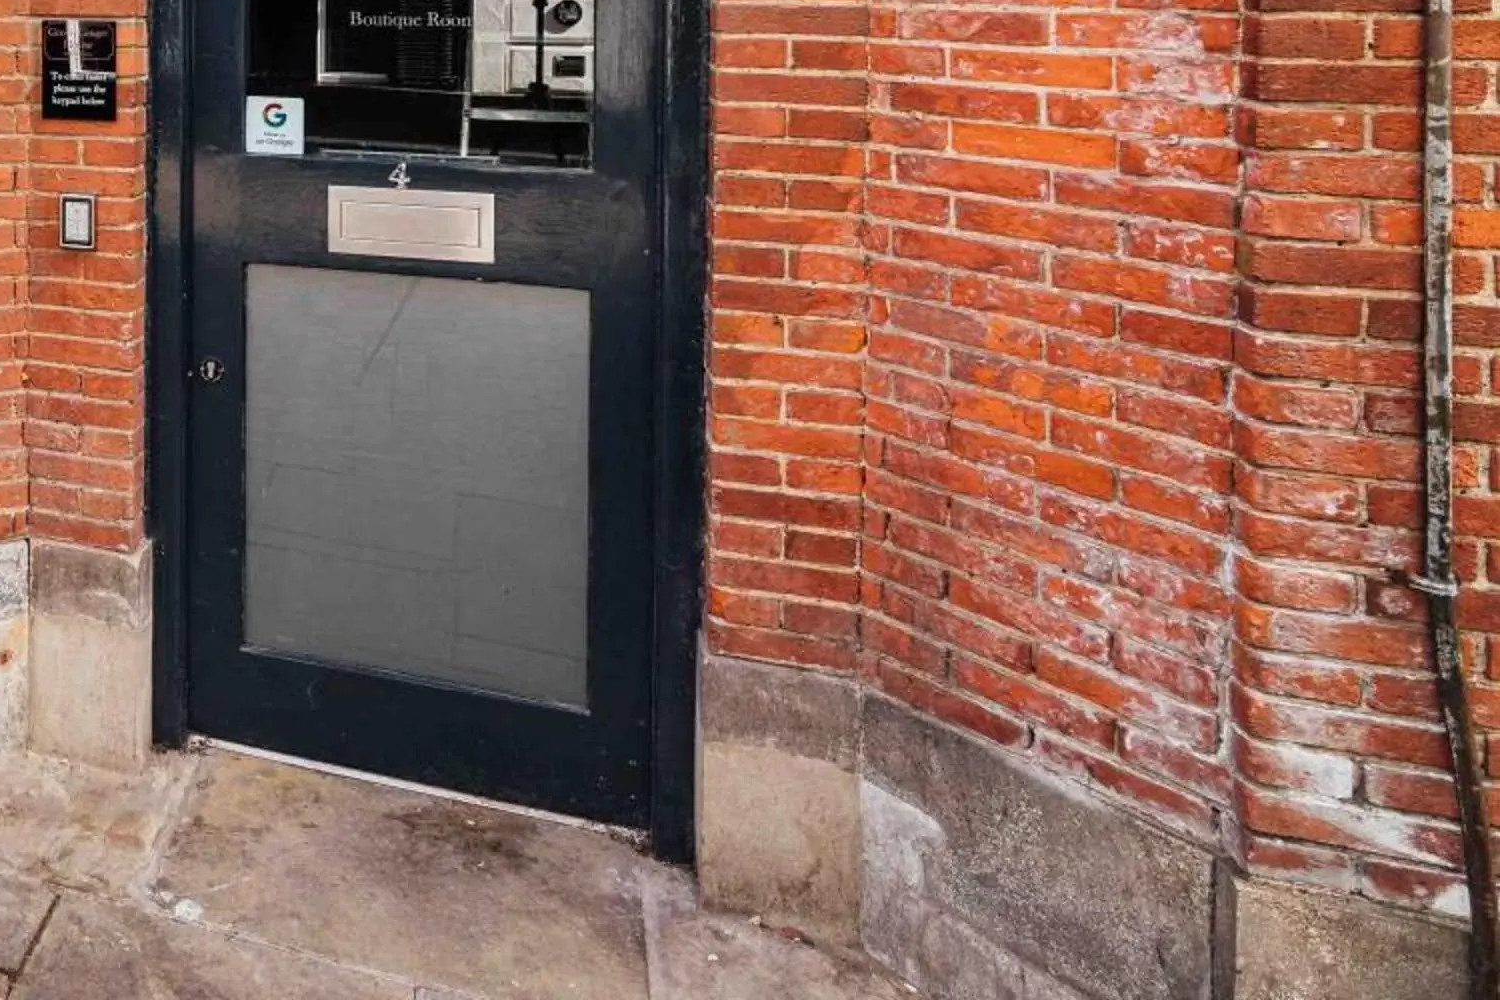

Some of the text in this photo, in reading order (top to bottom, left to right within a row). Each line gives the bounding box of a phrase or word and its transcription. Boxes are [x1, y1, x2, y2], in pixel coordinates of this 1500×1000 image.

[349, 11, 421, 29] Boutique
[52, 96, 104, 107] keypad below
[388, 162, 412, 189] 4
